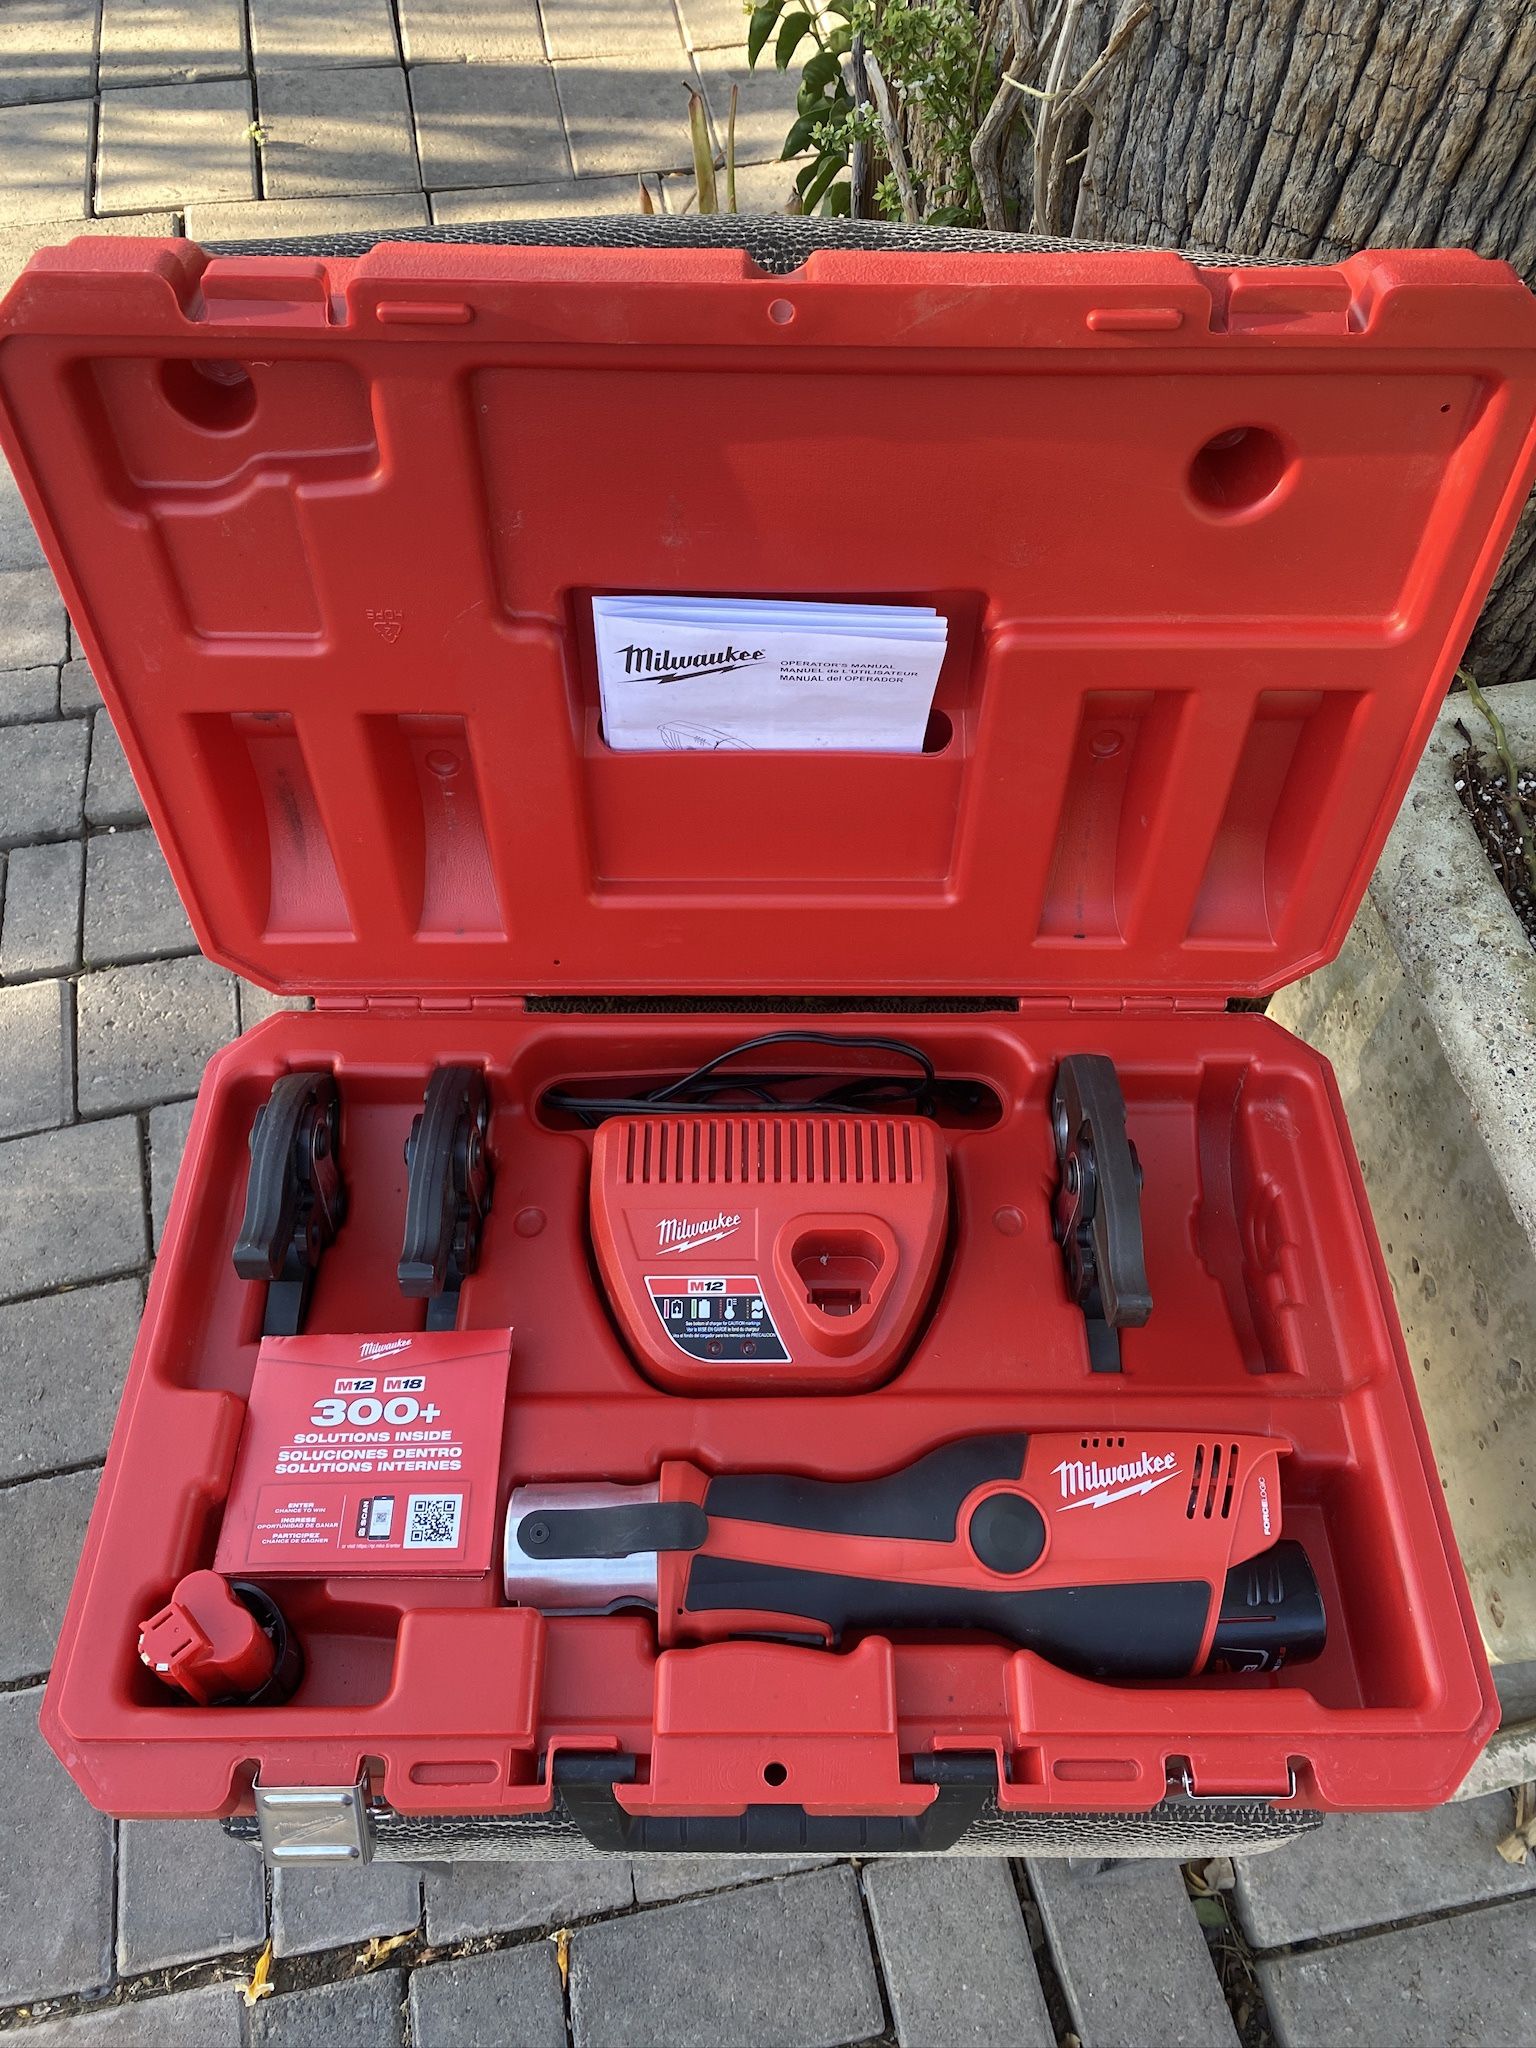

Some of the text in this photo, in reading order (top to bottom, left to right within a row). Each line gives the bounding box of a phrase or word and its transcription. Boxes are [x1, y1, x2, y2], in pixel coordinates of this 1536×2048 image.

[366, 608, 402, 619] HDPE
[614, 644, 766, 674] Milwaukee
[780, 660, 848, 668] OPERATOR'S
[842, 669, 919, 677] L'UTILISATEUR
[656, 1212, 741, 1245] Milwaukee
[690, 1281, 724, 1291] M12
[359, 1339, 412, 1357] Milwaukee
[337, 1379, 423, 1391] M12 M18
[310, 1396, 441, 1427] 300+
[293, 1430, 452, 1444] SOLUTIONS INSIDE
[278, 1447, 462, 1462] SOLUCIONES DENTRO
[275, 1460, 462, 1474] SOLUTIONS INTERNES
[1050, 1451, 1179, 1499] Milwaukee
[361, 1500, 369, 1526] SCAN
[1258, 1476, 1271, 1535] FORCELOGIC
